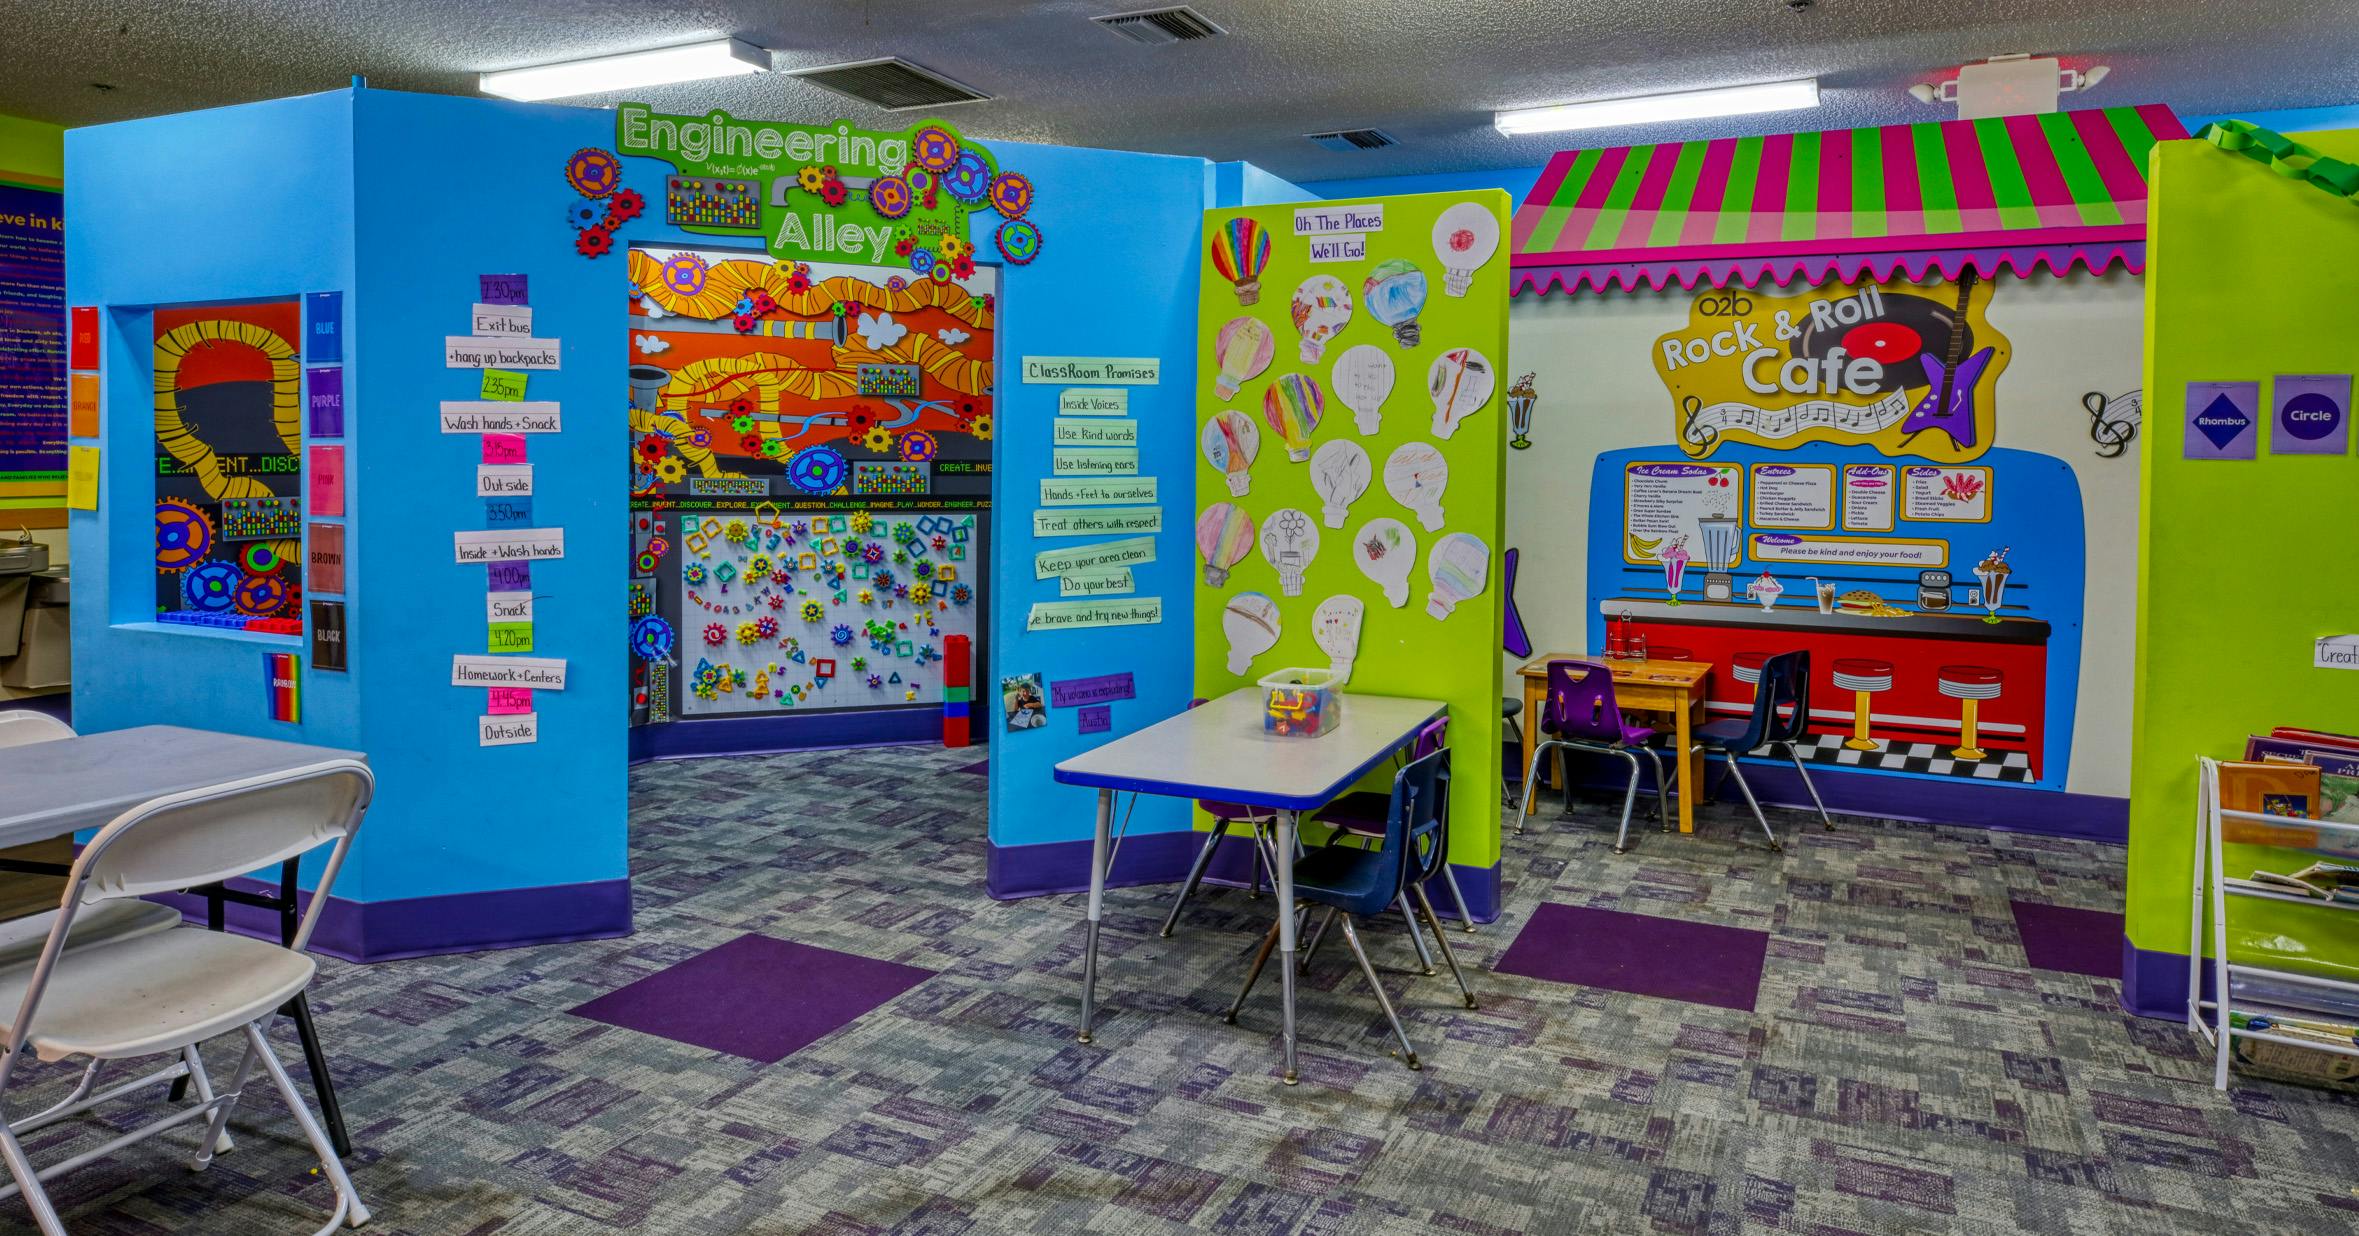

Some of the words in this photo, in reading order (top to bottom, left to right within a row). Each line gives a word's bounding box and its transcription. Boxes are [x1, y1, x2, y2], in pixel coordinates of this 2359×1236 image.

[623, 106, 907, 177] Engineering
[30, 213, 47, 229] in
[1295, 216, 1312, 231] Oh
[1315, 215, 1340, 230] The
[1345, 213, 1382, 229] Places
[774, 212, 892, 264] Alley
[1311, 242, 1340, 258] We'll
[1344, 241, 1365, 257] Go!
[315, 322, 334, 335] BLUE
[476, 316, 506, 332] Exit
[509, 318, 531, 333] bus
[1661, 319, 1764, 372] Rock
[1773, 310, 1801, 342] &
[1808, 284, 1886, 334] Roll
[484, 353, 497, 367] up
[499, 350, 556, 368] backpacks
[1105, 363, 1155, 379] Promises
[1741, 346, 1884, 395] Cafe
[73, 402, 97, 413] ORANGE
[312, 394, 340, 408] PURPLE
[1063, 398, 1089, 410] Inside
[1090, 398, 1120, 411] Voices
[445, 416, 478, 430] Wash
[482, 415, 513, 430] hands
[522, 416, 557, 430] Snack
[2199, 416, 2246, 427] Rhombus
[2290, 410, 2332, 422] Circle
[1058, 427, 1077, 440] Use
[1105, 428, 1135, 441] words
[939, 463, 970, 472] CREATE
[1056, 458, 1074, 470] Use
[1077, 458, 1113, 473] listening
[1115, 461, 1135, 470] ears
[1636, 466, 1650, 475] Ice
[1650, 465, 1679, 476] Cream
[1681, 466, 1708, 475] Sodas
[1760, 466, 1792, 476] Entrees
[1847, 466, 1888, 476] Add-Ons
[1911, 467, 1938, 477] Sides
[317, 473, 335, 486] PINK
[1044, 488, 1073, 500] Hands
[1101, 488, 1110, 498] to
[1113, 488, 1153, 499] ourselves
[1037, 518, 1067, 530] Treat
[1073, 518, 1104, 530] others
[1106, 519, 1124, 529] with
[1126, 515, 1158, 529] respect
[1762, 535, 1795, 544] Welcome
[311, 551, 341, 565] BROWN
[459, 546, 487, 560] Inside
[498, 545, 530, 557] Wash
[533, 545, 562, 556] hands
[1780, 547, 1806, 555] Please
[1819, 548, 1838, 556] kind
[1856, 550, 1879, 559] enjoy
[1879, 551, 1899, 559] your
[1900, 551, 1922, 559] food!
[1038, 559, 1071, 573] Keep
[1075, 558, 1095, 570] your
[1099, 554, 1120, 564] area
[1121, 549, 1146, 561] clean
[1063, 577, 1081, 591] Do
[1083, 581, 1105, 594] your
[1106, 576, 1129, 588] best
[494, 602, 527, 616] Snack
[1045, 611, 1073, 624] brave
[1076, 610, 1092, 622] and
[1095, 610, 1109, 624] try
[1111, 610, 1129, 620] new
[1132, 607, 1158, 622] things!
[317, 628, 340, 642] BLACK
[485, 725, 532, 740] Outside
